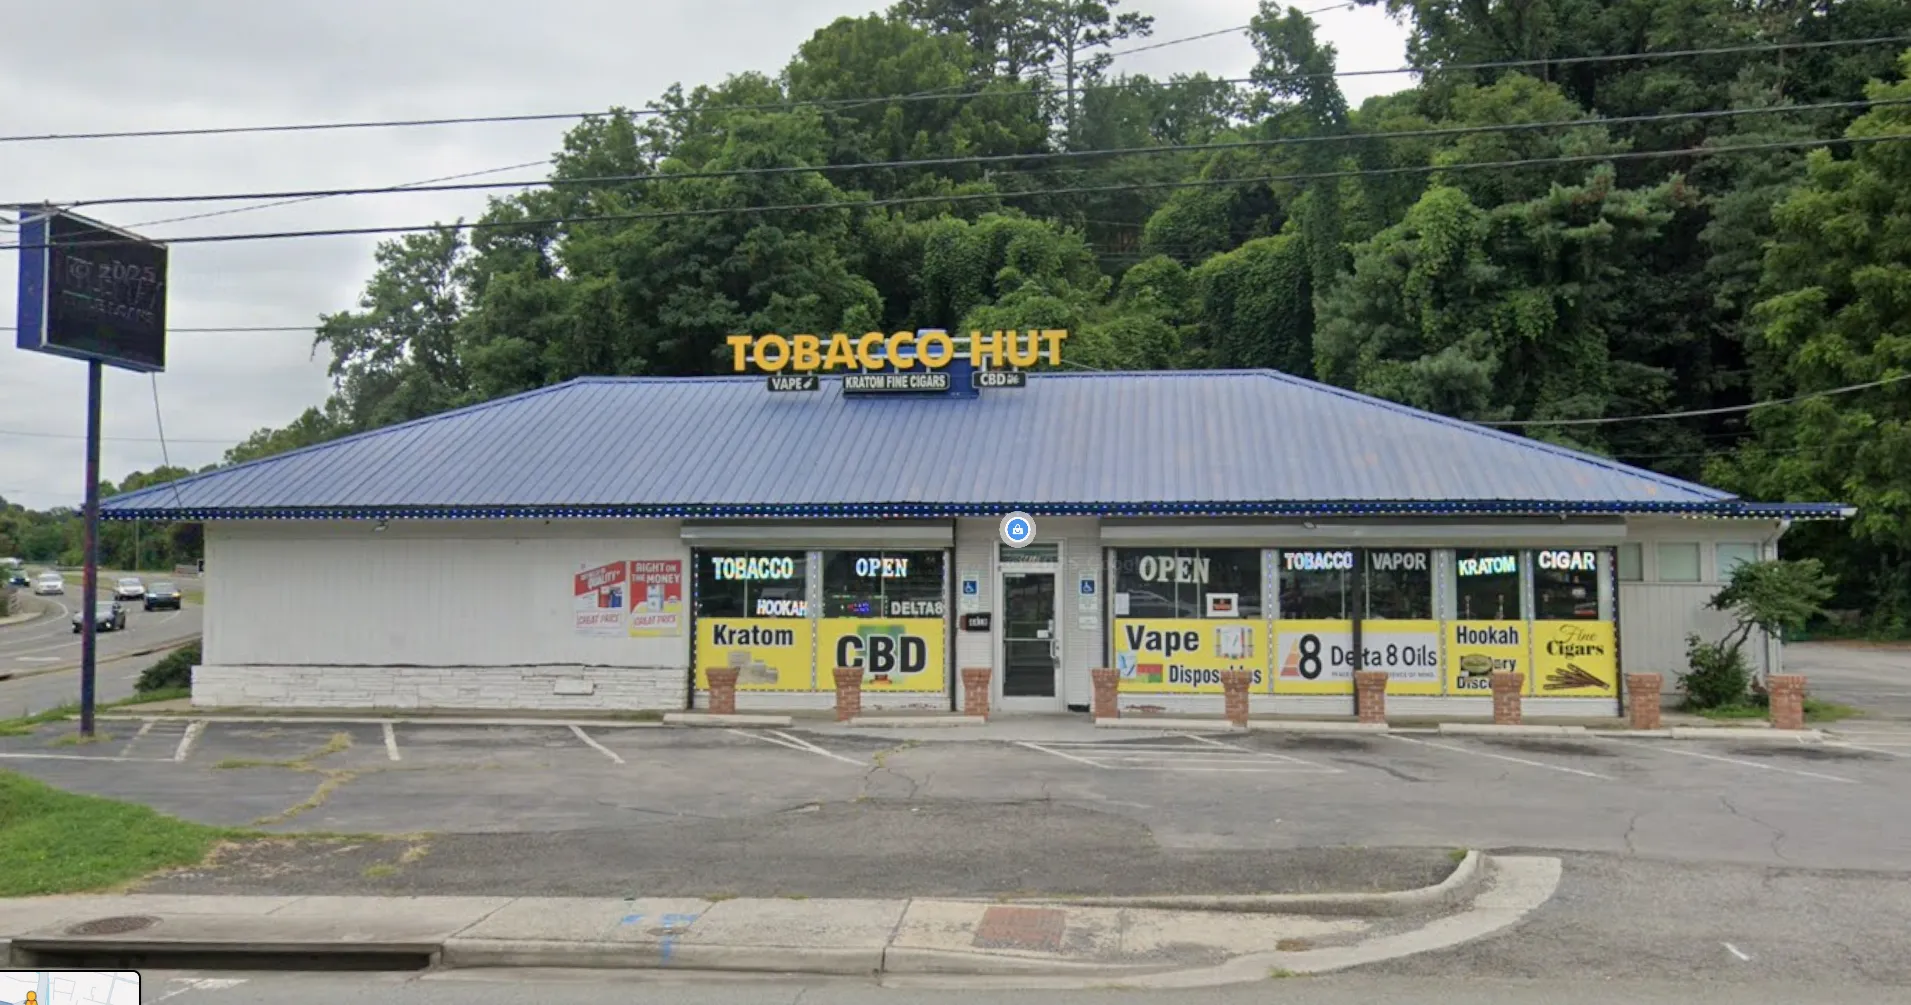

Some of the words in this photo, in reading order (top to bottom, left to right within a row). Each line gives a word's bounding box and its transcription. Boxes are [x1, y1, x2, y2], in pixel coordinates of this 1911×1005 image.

[726, 331, 954, 372] TOBACCO
[970, 329, 1068, 367] HUT
[771, 377, 803, 390] VAPE
[845, 376, 885, 389] KRATOM
[886, 375, 908, 388] FINE
[909, 374, 946, 388] CIGARS
[980, 373, 1006, 386] CBD
[636, 562, 665, 573] RIGHT
[712, 556, 794, 581] TOBACCO
[855, 557, 908, 578] OPEN
[1139, 555, 1211, 584] OPEN
[1284, 551, 1354, 570] TOBACCO
[1372, 552, 1427, 570] VAPOR
[1458, 556, 1517, 576] KRATOM
[1538, 551, 1596, 571] CIGAR
[646, 574, 681, 584] MONEY
[757, 599, 808, 616] HOOKAH
[890, 601, 943, 615] DELTA8
[713, 624, 794, 646] Kratom
[1126, 624, 1200, 657] Vape
[1456, 625, 1519, 645] Hookah
[1557, 624, 1598, 642] Fine
[836, 635, 927, 674] CBD
[1299, 634, 1322, 680] 8
[1331, 645, 1383, 666] Deta
[1386, 644, 1399, 666] 8
[1403, 644, 1438, 667] Oils
[1546, 641, 1605, 660] Cigars
[1169, 664, 1262, 688] Disposs
